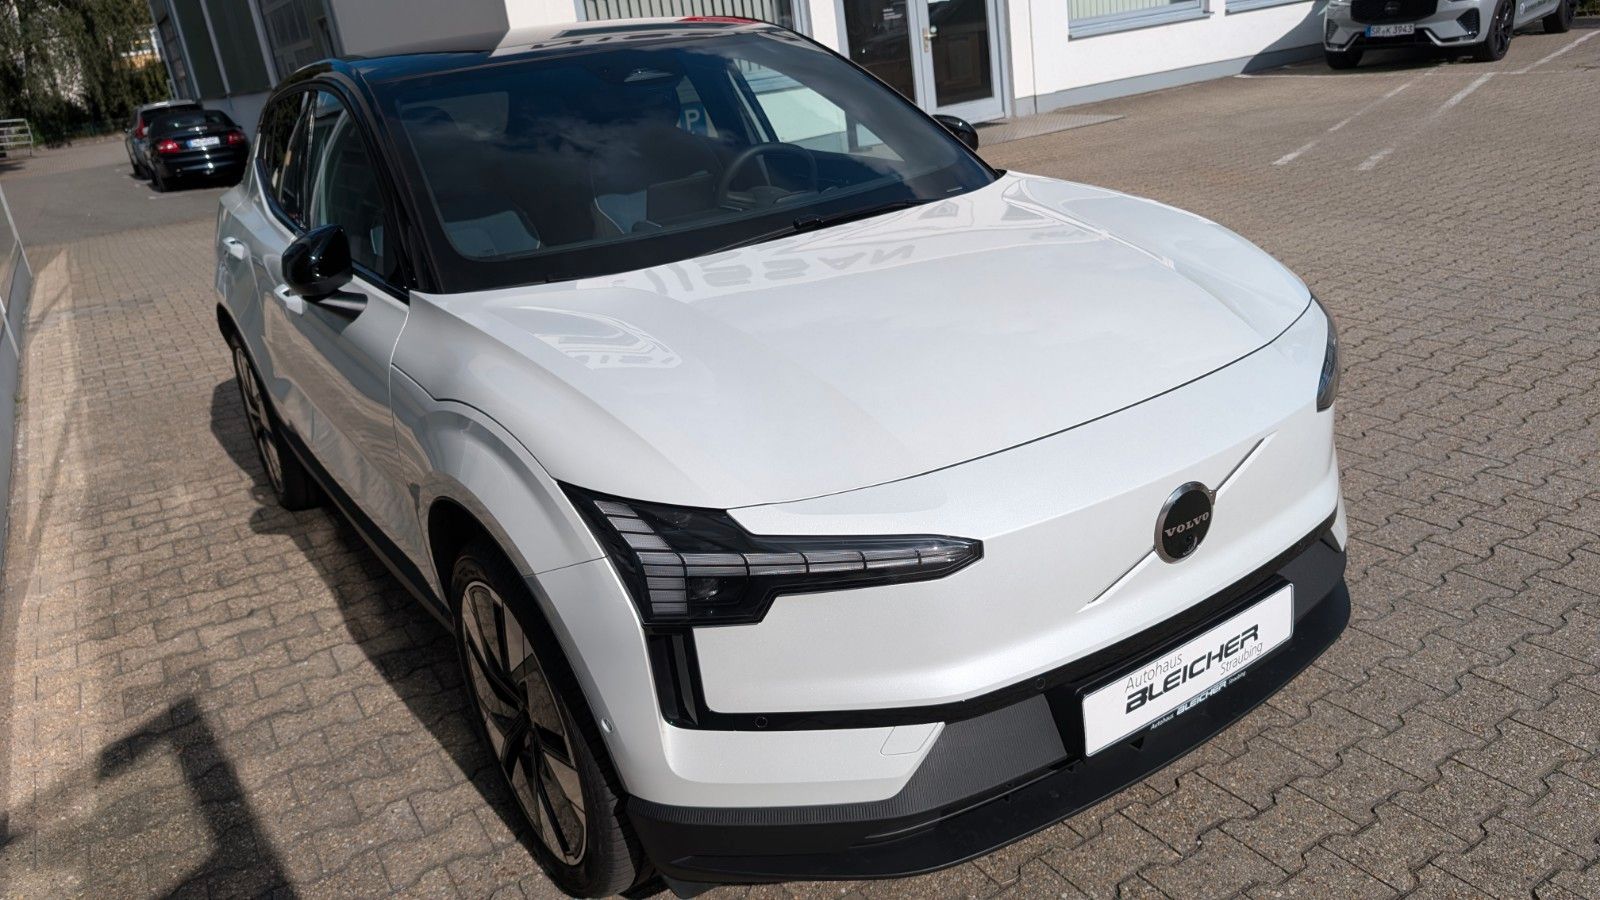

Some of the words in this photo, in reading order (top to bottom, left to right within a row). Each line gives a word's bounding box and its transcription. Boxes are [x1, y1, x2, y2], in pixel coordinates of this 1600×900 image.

[685, 109, 700, 131] P
[1164, 511, 1210, 537] VOLVO
[1125, 624, 1259, 714] BLEICHER
[1125, 653, 1183, 693] Autohaus
[1219, 641, 1264, 676] Straubing
[1176, 681, 1228, 716] BLEICHER
